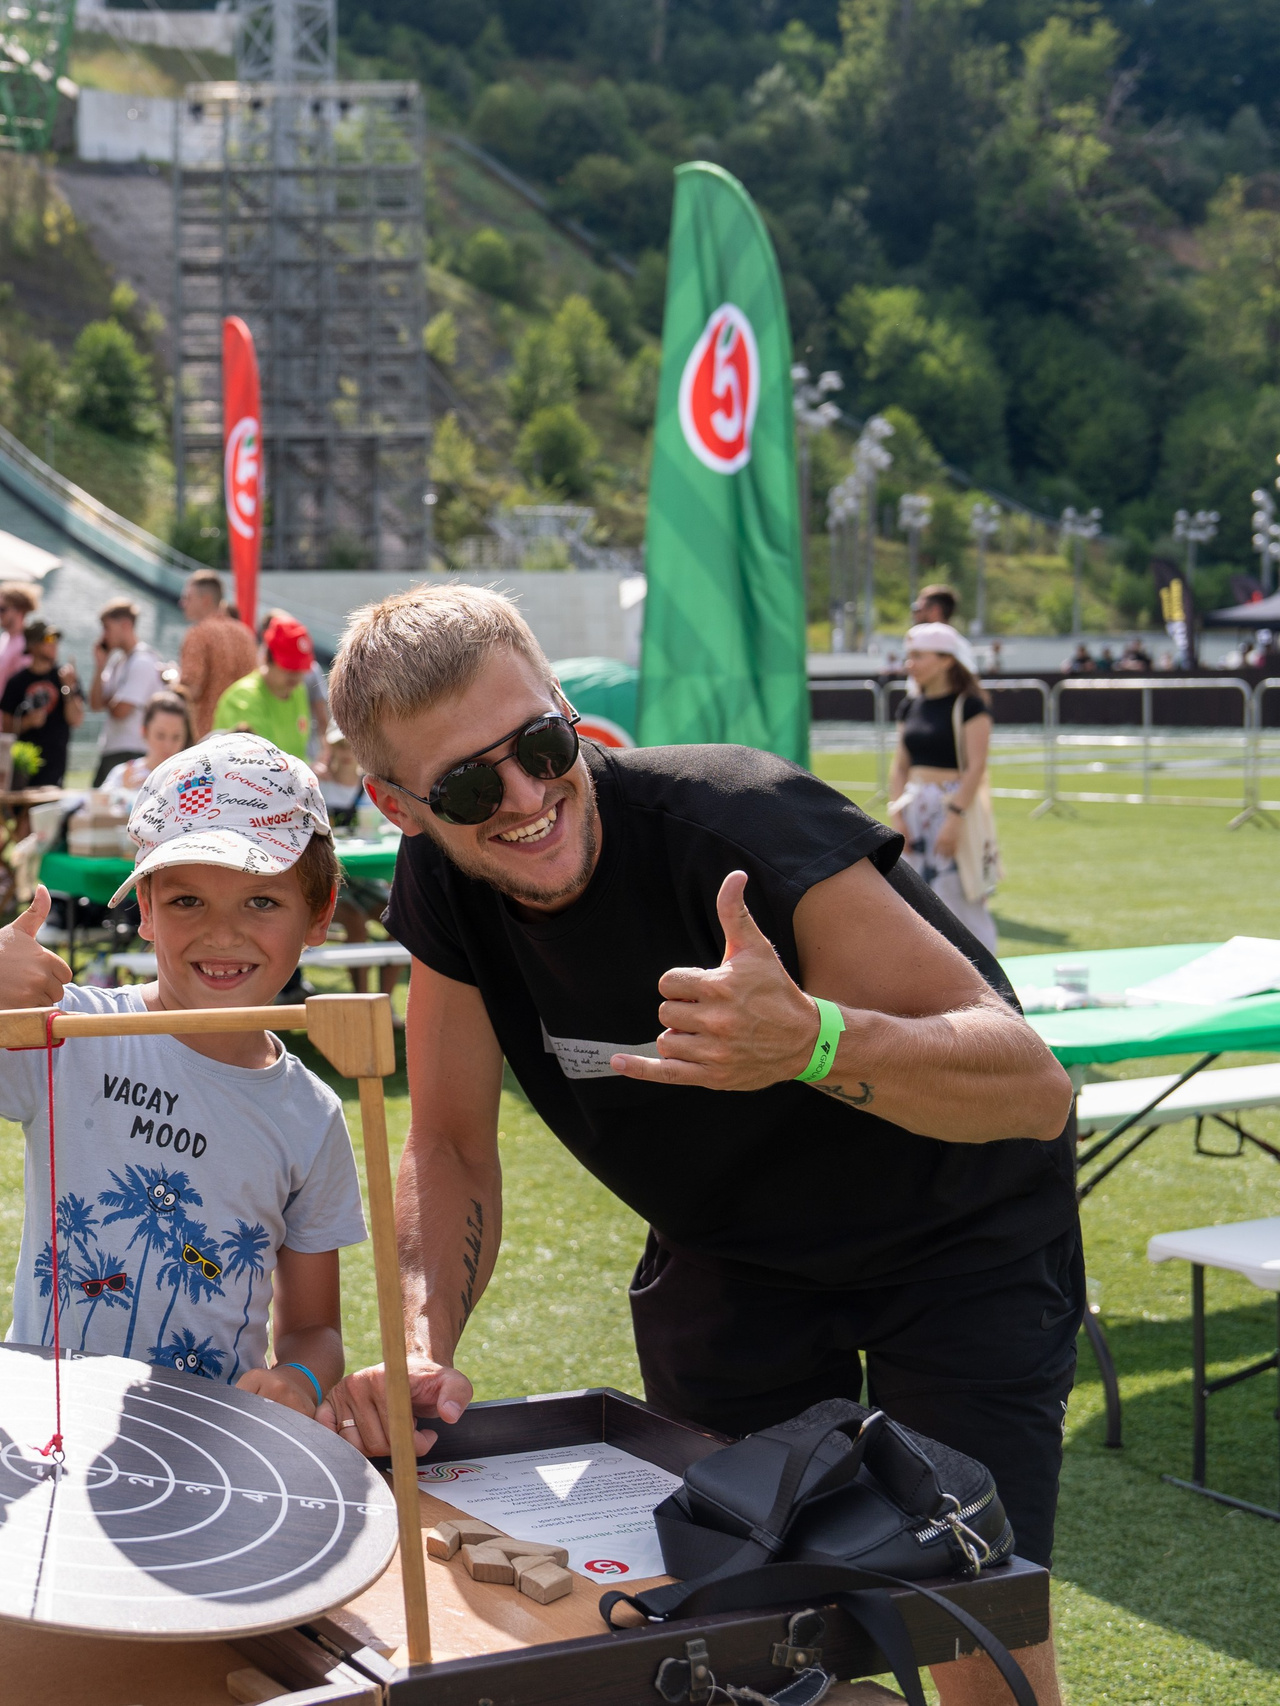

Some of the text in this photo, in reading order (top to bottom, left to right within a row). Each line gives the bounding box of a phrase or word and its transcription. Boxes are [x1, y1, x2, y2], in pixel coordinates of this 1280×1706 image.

[224, 771, 273, 796] Croazia
[216, 793, 269, 810] Croatia
[104, 1073, 179, 1116] VACAY
[130, 1115, 207, 1158] MOOD
[128, 1476, 154, 1488] 2
[185, 1484, 212, 1496] 3
[242, 1492, 268, 1504] 4
[300, 1499, 326, 1511] 5
